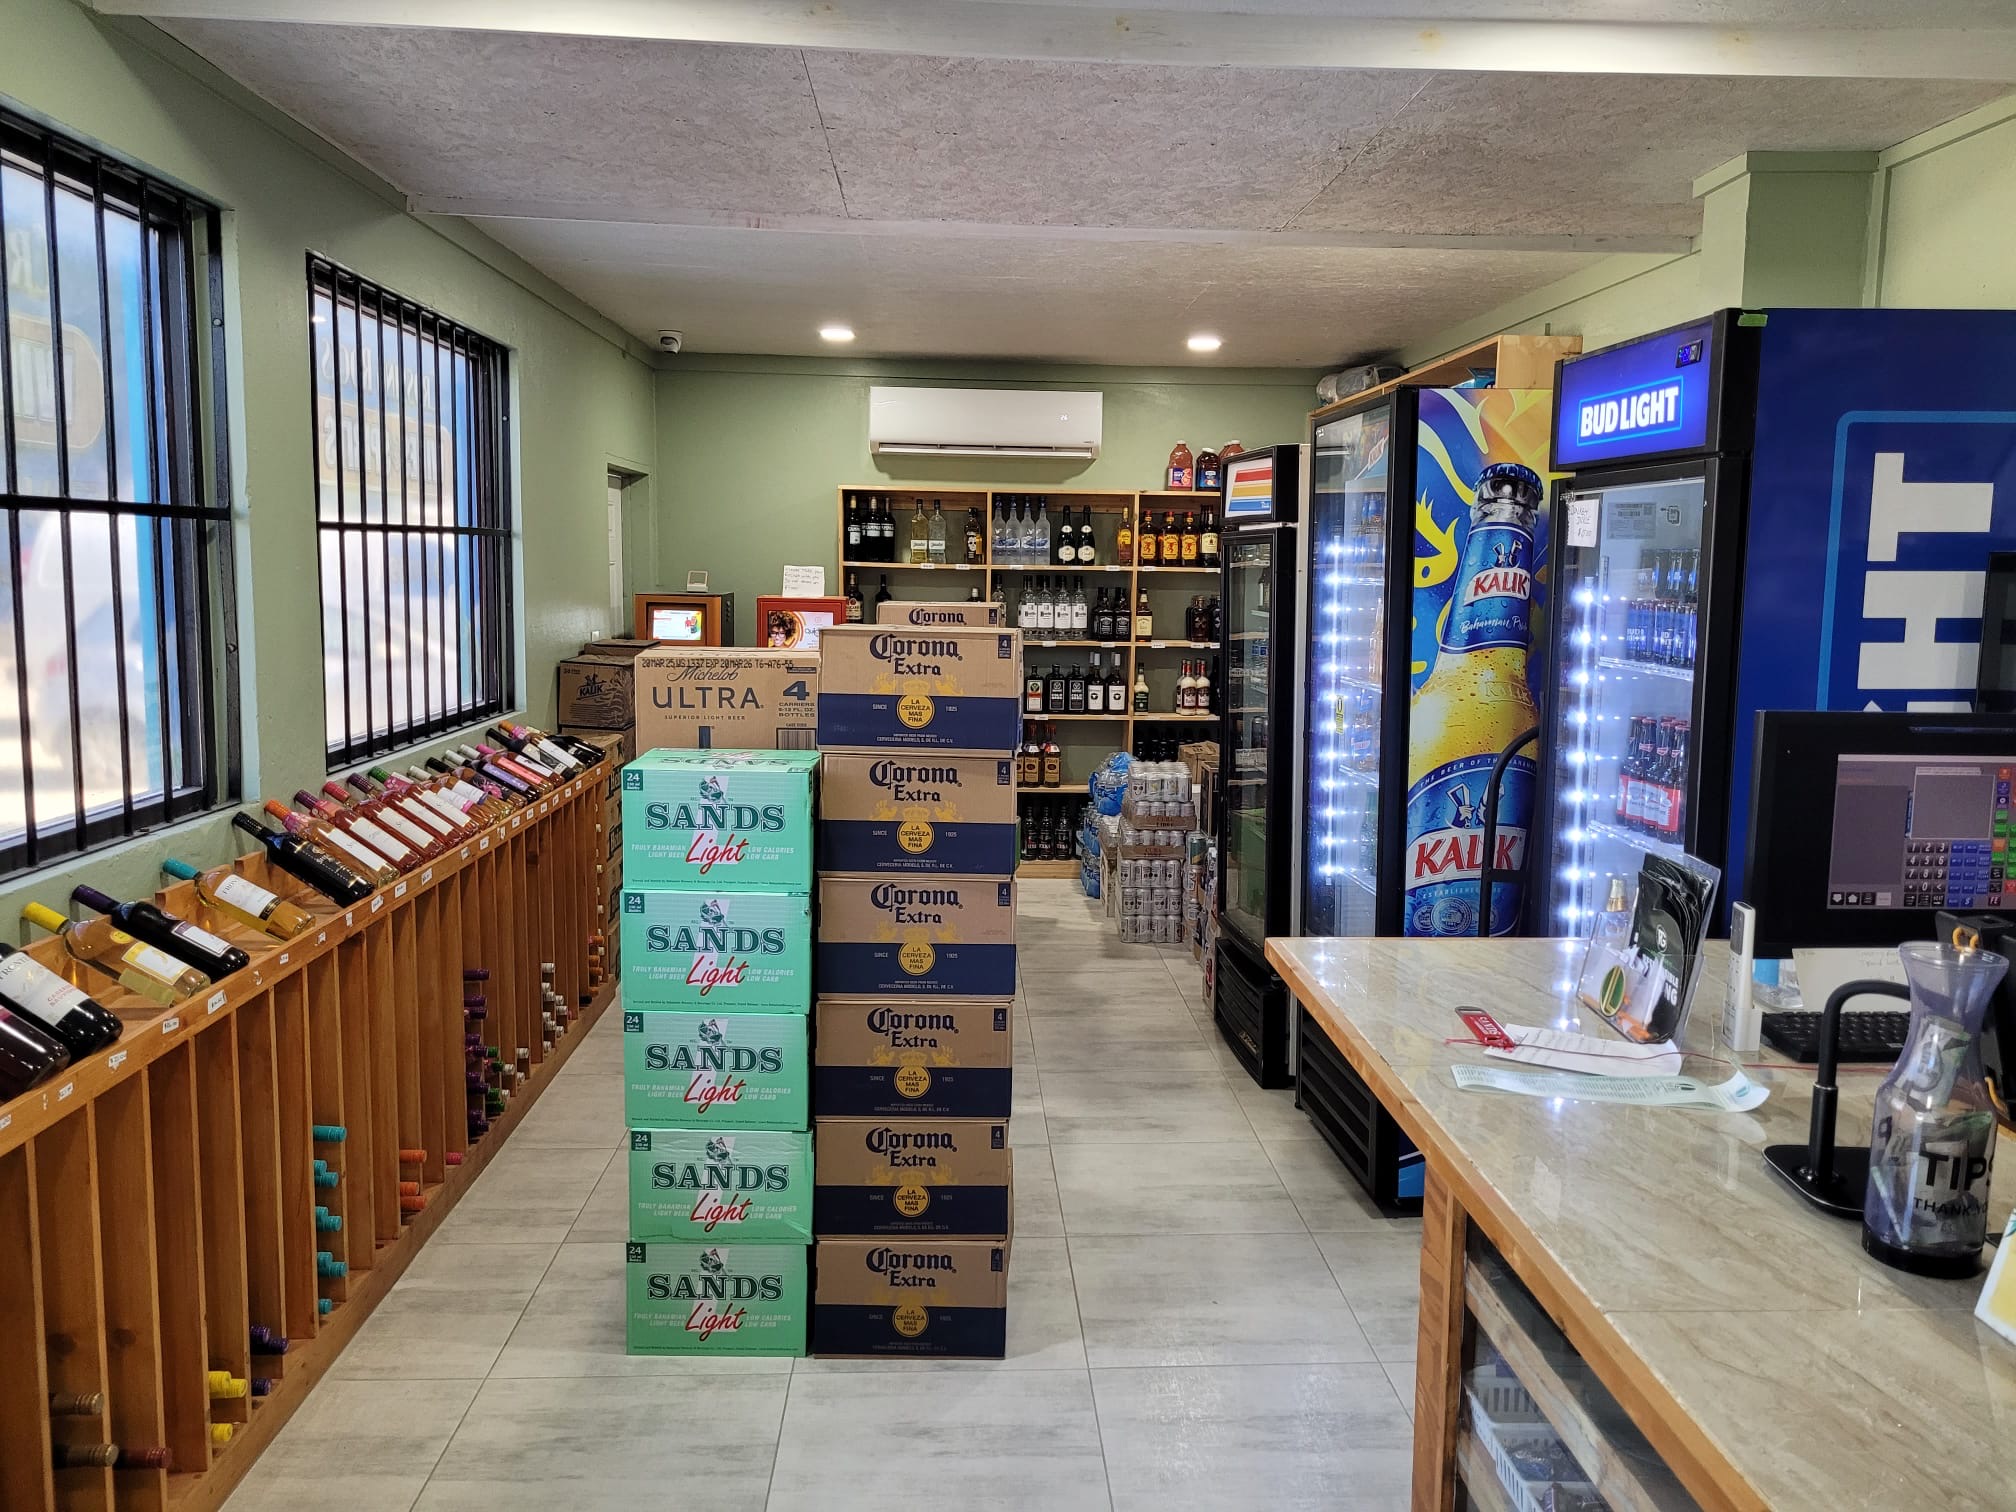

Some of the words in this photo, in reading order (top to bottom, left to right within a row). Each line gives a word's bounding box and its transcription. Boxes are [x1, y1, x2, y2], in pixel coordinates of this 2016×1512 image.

[1580, 401, 1619, 437] BUD
[1620, 386, 1679, 430] LIGHT
[1474, 572, 1527, 596] KALIK
[909, 608, 965, 626] Corona
[870, 634, 959, 662] Corona
[667, 666, 738, 682] Michelob
[894, 658, 941, 675] Extra
[580, 684, 603, 697] KALIK
[653, 687, 760, 709] ULTRA
[783, 681, 810, 701] 4
[627, 773, 640, 781] 24
[869, 760, 959, 789] Corona
[1001, 766, 1006, 774] 4
[1420, 775, 1435, 788] THE
[1440, 763, 1465, 775] BEER
[894, 784, 941, 802] Extra
[645, 802, 785, 832] SANDS
[685, 833, 749, 875] Light
[1912, 843, 1915, 851] 1
[1926, 843, 1930, 851] 2
[1940, 843, 1945, 851] 3
[1415, 834, 1518, 879] KALK
[1910, 856, 1915, 864] 4
[1924, 856, 1929, 864] 5
[1939, 856, 1944, 864] 6
[1909, 869, 1914, 878] 7
[1923, 869, 1928, 878] 8
[1938, 870, 1943, 878] 9
[1922, 882, 1927, 891] 0
[629, 896, 641, 904] 24
[871, 884, 959, 912] Corona
[895, 907, 942, 924] Extra
[646, 925, 785, 954] SANDS
[686, 955, 749, 996] Light
[626, 1016, 639, 1024] 24
[867, 1008, 955, 1036] Corona
[891, 1031, 938, 1048] Extra
[645, 1044, 783, 1073] SANDS
[684, 1074, 746, 1114] Light
[635, 1134, 648, 1142] 24
[866, 1127, 954, 1156] Corona
[890, 1151, 936, 1167] Extra
[652, 1162, 789, 1192] SANDS
[690, 1193, 752, 1233] Light
[866, 1248, 954, 1276] Corona
[648, 1274, 783, 1300] SANDS
[890, 1271, 936, 1287] Extra
[685, 1303, 747, 1341] Light
